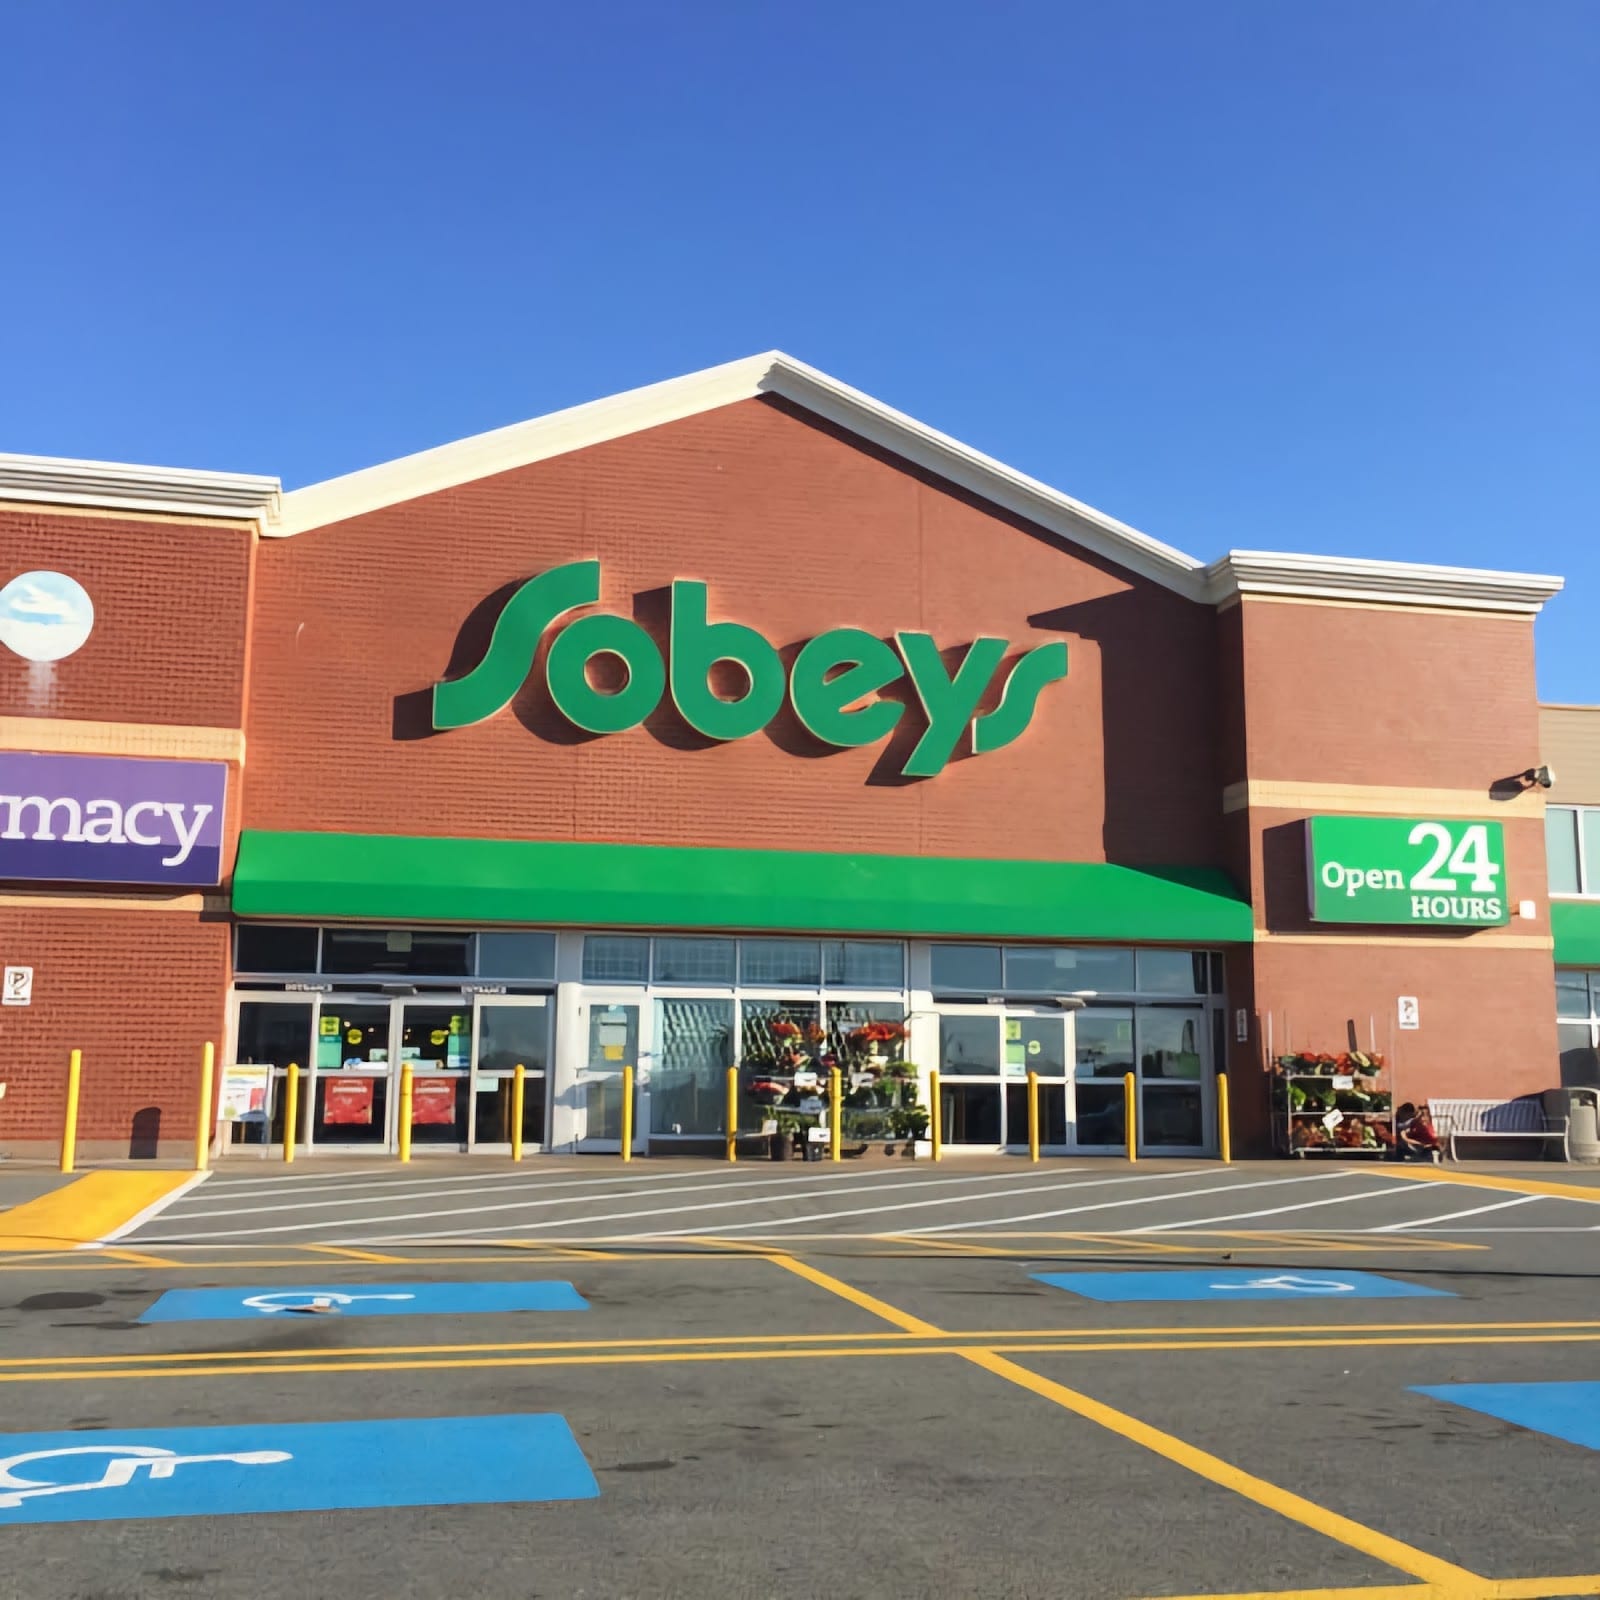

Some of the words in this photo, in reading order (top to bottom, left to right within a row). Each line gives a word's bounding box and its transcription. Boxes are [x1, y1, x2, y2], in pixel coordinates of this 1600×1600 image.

[433, 558, 1068, 777] Sobeys
[0, 793, 213, 867] macy
[1321, 861, 1405, 896] Open
[1408, 822, 1500, 892] 24
[1411, 895, 1502, 920] HOURS
